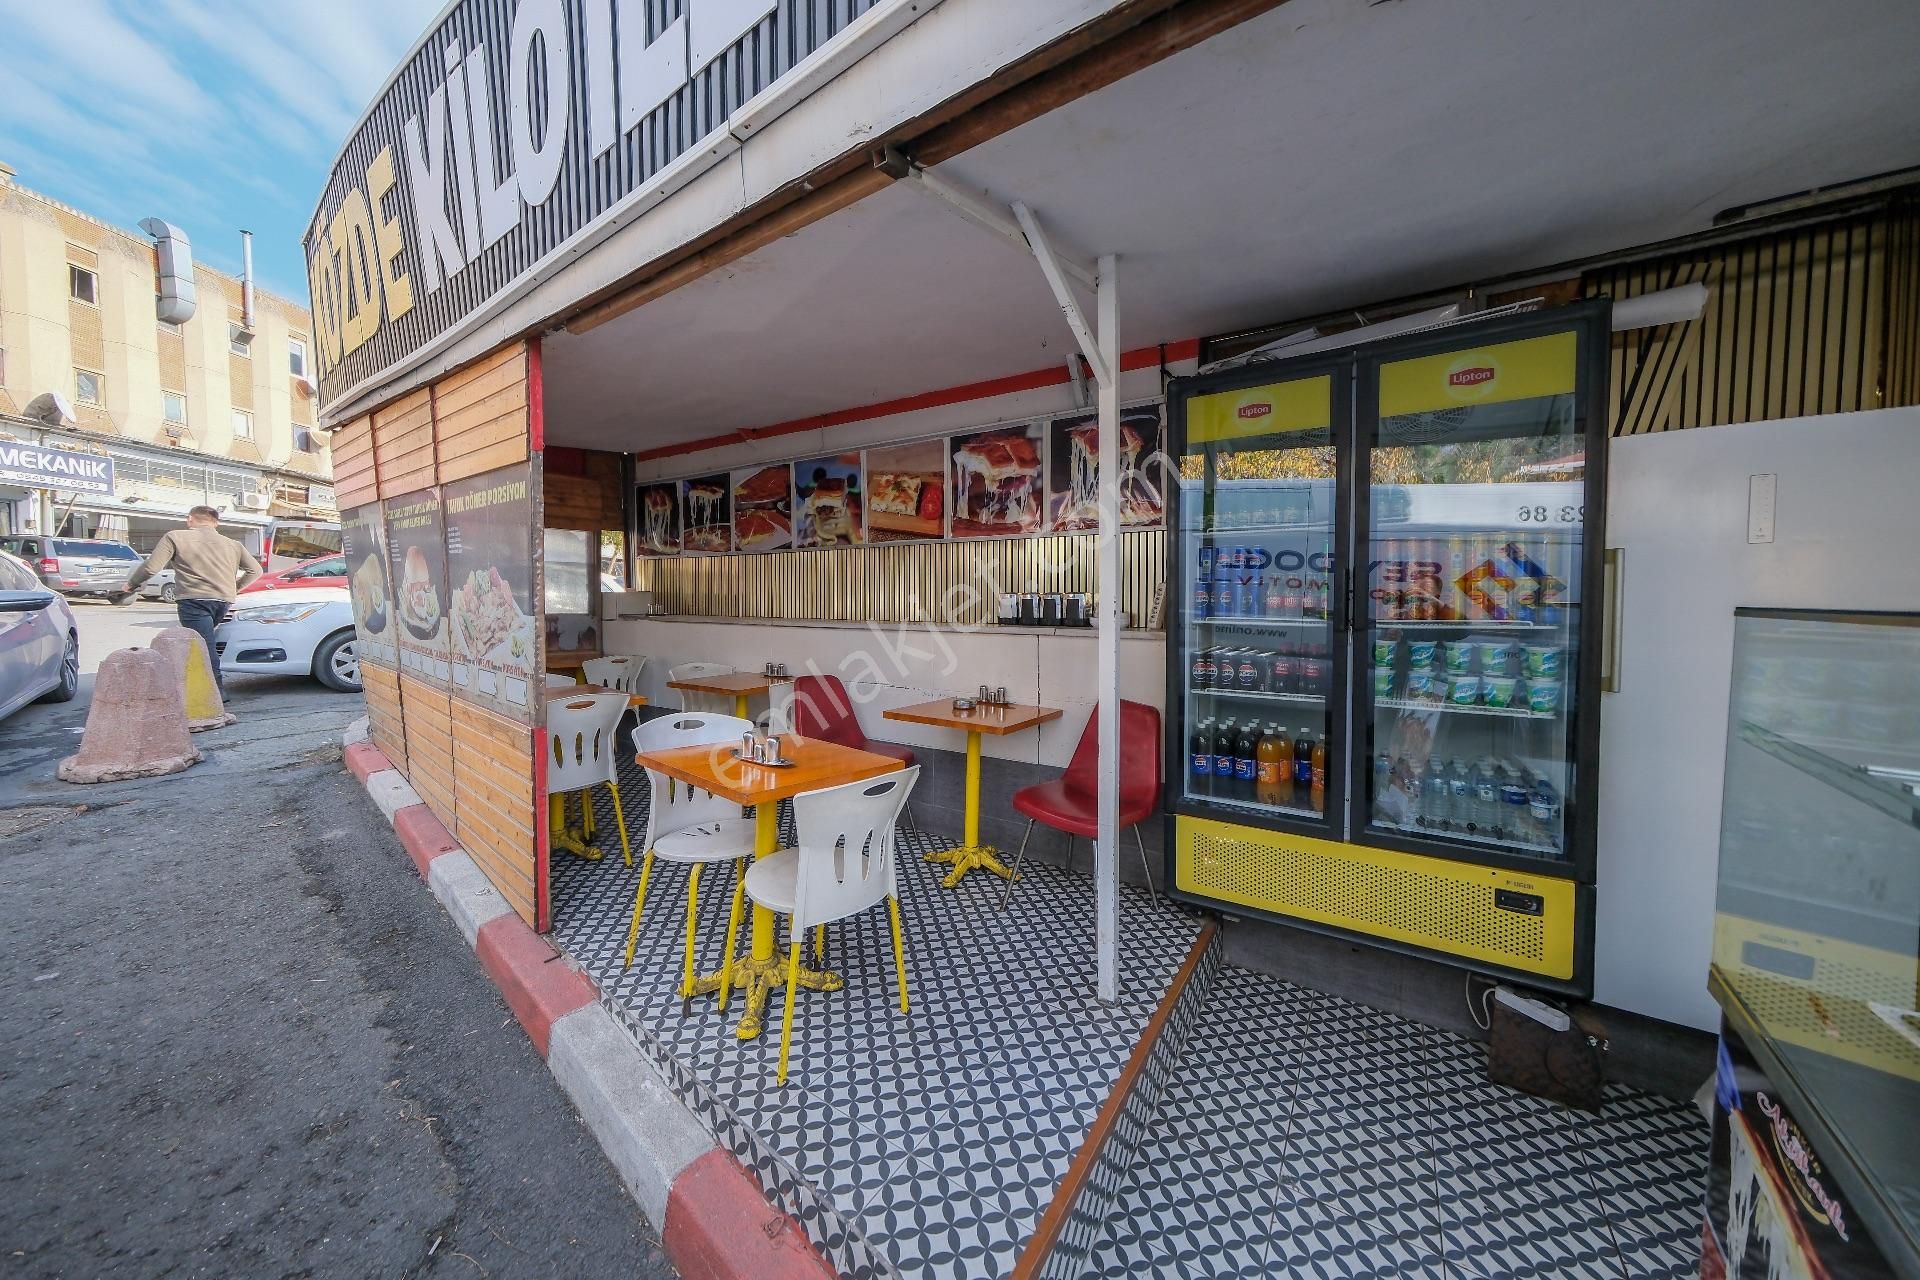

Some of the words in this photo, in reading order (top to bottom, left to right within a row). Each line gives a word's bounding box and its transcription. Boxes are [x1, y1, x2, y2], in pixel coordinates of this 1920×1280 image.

[1453, 370, 1491, 384] Lipton
[1240, 406, 1269, 417] Lipton
[465, 490, 487, 511] DÖNER
[487, 481, 526, 506] PORSİYON
